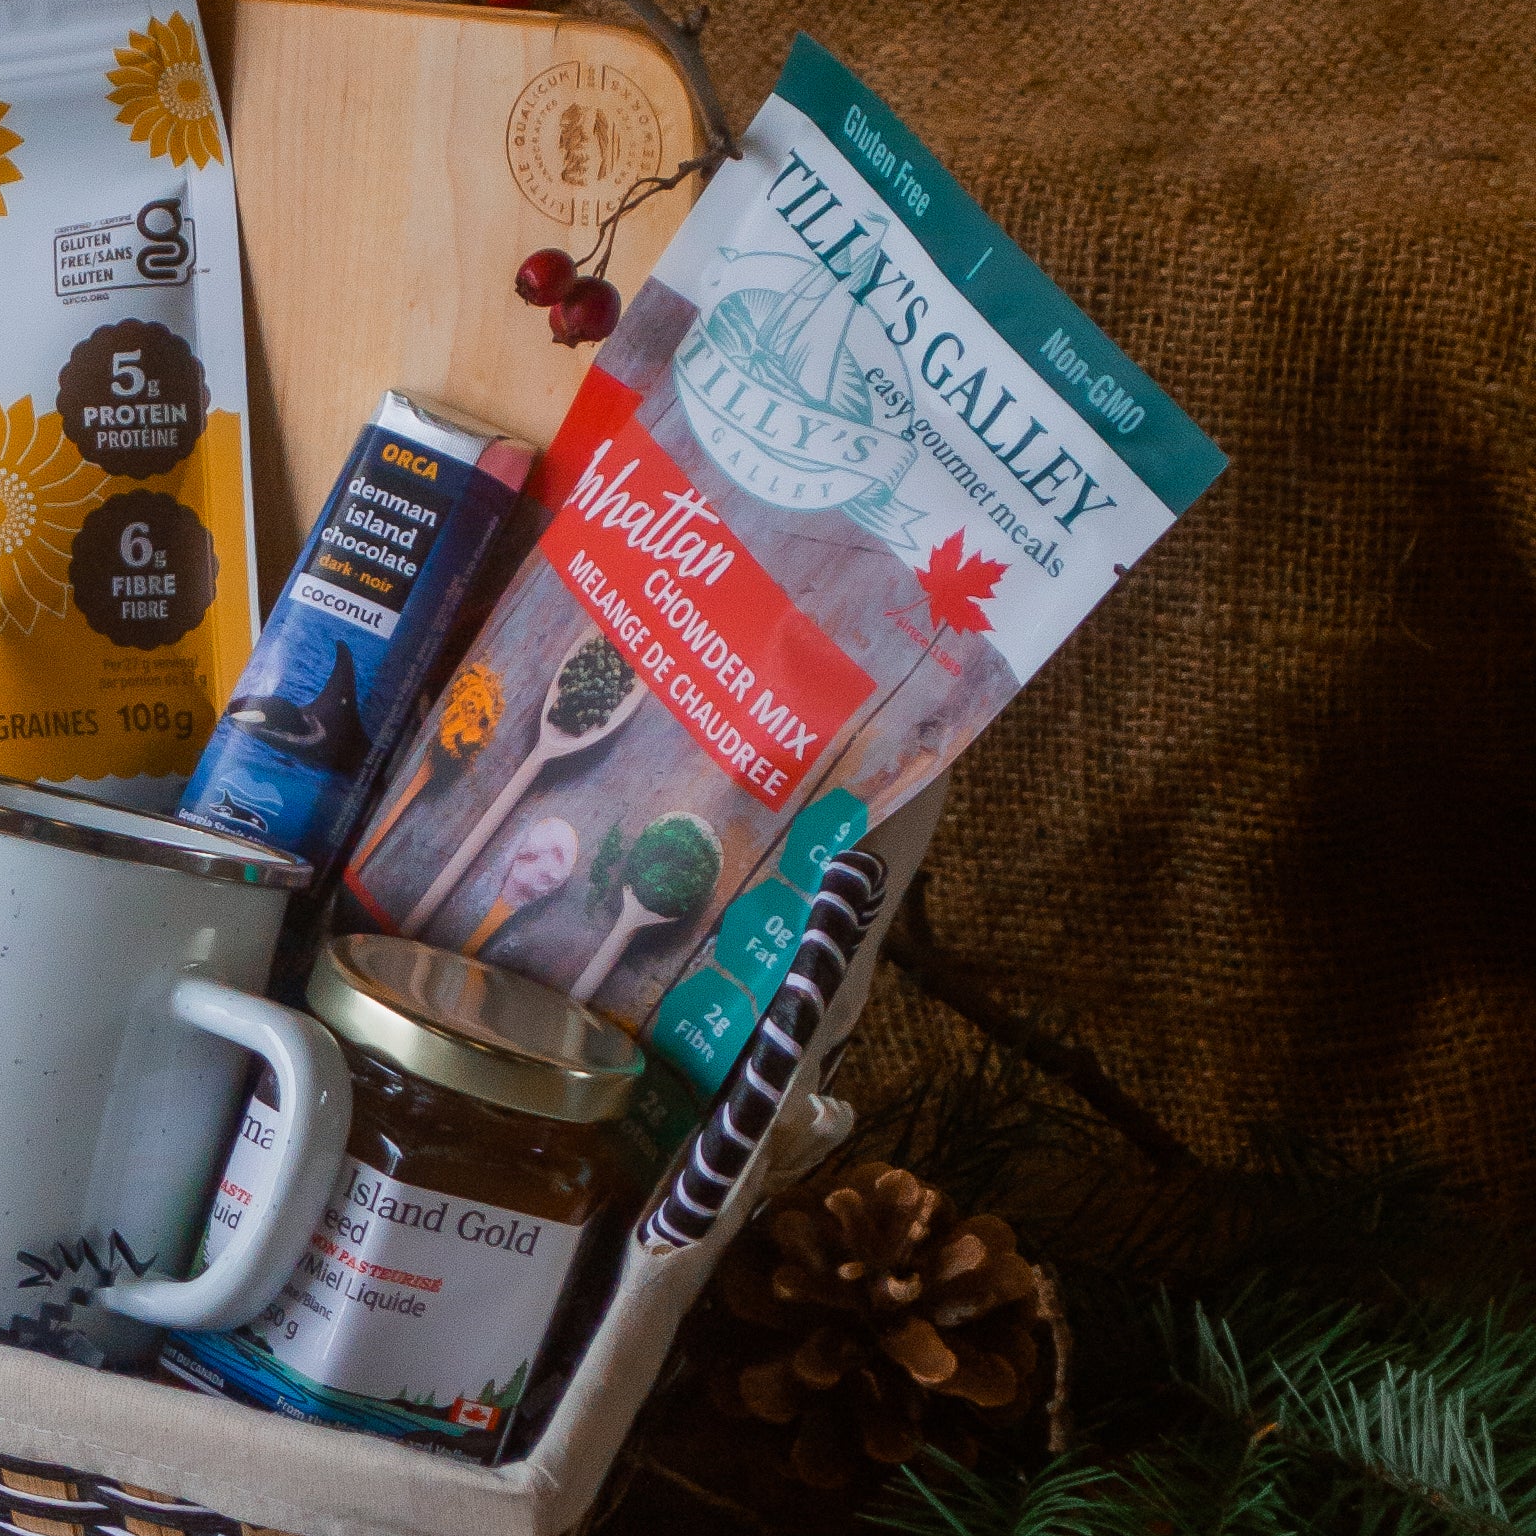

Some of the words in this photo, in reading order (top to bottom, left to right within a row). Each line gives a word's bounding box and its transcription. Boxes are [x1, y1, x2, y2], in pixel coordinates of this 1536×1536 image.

[514, 71, 571, 148] QUALICUM
[518, 162, 565, 213] LITTLE
[60, 231, 112, 253] GLUTEN
[61, 246, 134, 269] FREE/SANS
[61, 267, 114, 288] GLUTEN
[843, 103, 898, 179] Gluten
[893, 158, 932, 219] Free
[1039, 326, 1146, 437] Non-GMO
[765, 147, 931, 348] TILLY'S
[919, 330, 1118, 536] GALLEY
[111, 348, 161, 398] 5g
[82, 403, 188, 428] PROTEIN
[679, 329, 878, 464] TILLY'S
[96, 424, 179, 450] PROTÉINE
[381, 442, 440, 482] ORCA
[710, 426, 833, 500] GALLEY
[864, 365, 918, 421] easy
[901, 419, 1000, 511] gourmet
[988, 500, 1066, 579] meals
[348, 476, 438, 528] denman
[119, 521, 168, 569] 6g
[344, 502, 418, 550] island
[321, 525, 417, 577] chocolate
[111, 573, 177, 598] FIBRE
[319, 553, 353, 577] dark
[359, 571, 394, 593] noir
[120, 599, 169, 620] FIBRE
[301, 584, 385, 629] coconut
[895, 616, 930, 649] since
[566, 548, 652, 654] MELANGE
[640, 640, 676, 684] DE
[668, 673, 789, 797] CHAUDREE
[642, 566, 757, 703] CHOWDER
[748, 687, 819, 762] MIX
[116, 701, 195, 740] 108g
[765, 914, 795, 949] 0g
[744, 936, 780, 970] Fat
[703, 1003, 732, 1039] 2g
[324, 1207, 371, 1246] eed
[344, 1168, 449, 1234] Island
[456, 1209, 542, 1256] Gold
[344, 1272, 427, 1319] Liquide
[284, 1315, 300, 1341] g
[276, 1395, 306, 1423] From
